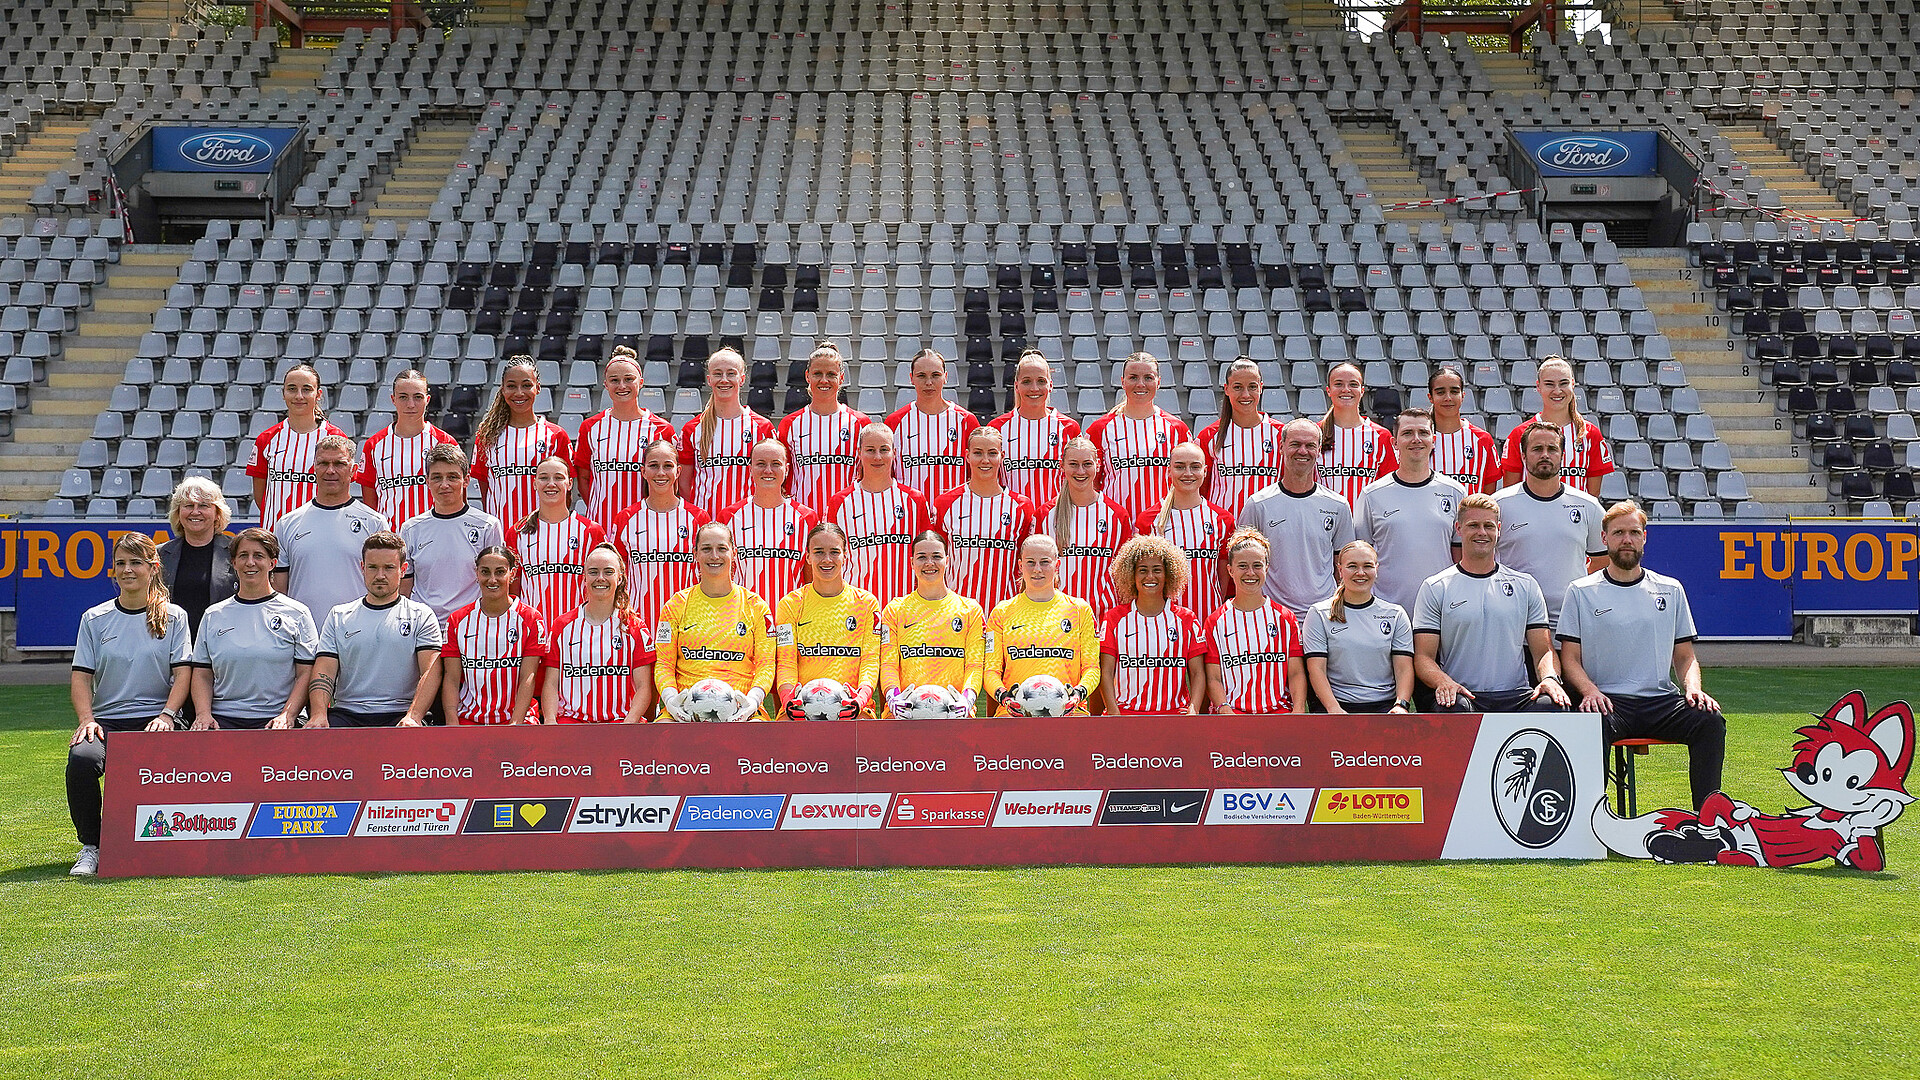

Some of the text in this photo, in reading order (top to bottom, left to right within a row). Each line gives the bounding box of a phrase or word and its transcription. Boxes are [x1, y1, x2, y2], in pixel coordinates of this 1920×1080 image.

[196, 136, 256, 162] Ford
[1553, 141, 1611, 165] Ford
[1678, 270, 1692, 280] 12
[1692, 292, 1705, 303] 11
[1705, 316, 1720, 327] 10
[1727, 340, 1734, 351] 9
[1742, 365, 1749, 377] 8
[1757, 391, 1765, 403] 7
[1774, 418, 1782, 430] 6
[1791, 446, 1799, 458] 5
[594, 459, 642, 473] Badeno
[698, 455, 751, 468] Badenov
[797, 454, 855, 467] Badenova
[903, 454, 964, 468] Badenova
[270, 469, 316, 483] Badeno
[492, 463, 537, 479] Badeno
[1218, 463, 1278, 477] Badenova
[1318, 464, 1376, 477] Badenova
[379, 474, 426, 490] Badeno
[1452, 474, 1478, 484] nova
[1809, 475, 1817, 487] 4
[1829, 504, 1836, 516] 3
[849, 532, 911, 549] Badenova
[953, 534, 1015, 550] Badenova
[631, 550, 694, 563] Badenova
[738, 546, 800, 561] Badenova
[1062, 545, 1112, 557] adenova
[1184, 549, 1218, 559] enova
[1719, 531, 1920, 581] EUROP
[523, 562, 584, 576] Badenova
[681, 646, 744, 661] Badenova
[797, 643, 860, 656] Badenova
[901, 644, 964, 658] Badenova
[1008, 645, 1073, 659] Badenova
[1119, 654, 1186, 668] Badenova
[1222, 652, 1286, 669] Badenova
[563, 664, 630, 678] Badenova
[855, 756, 946, 774] Badenova
[973, 755, 1065, 771] Badenova
[1091, 753, 1183, 770] Badenova
[1210, 751, 1301, 769] Badenova
[1330, 750, 1422, 768] Badenova
[381, 763, 473, 781] Badenova
[500, 761, 592, 779] Badenova
[619, 759, 711, 777] Badenova
[737, 758, 829, 775] Badenova
[138, 768, 232, 785] Badenova
[261, 766, 354, 783] Badenova
[1352, 793, 1410, 810] LOTTO
[273, 805, 338, 819] EUROPA
[367, 806, 435, 822] hilzinger
[576, 803, 671, 828] stryker
[688, 805, 773, 821] Badenova
[921, 808, 985, 823] Sparkasse
[1004, 802, 1092, 816] WeberHaus
[171, 811, 237, 835] Rothaus
[1352, 812, 1411, 821] Baden-Württemberg
[281, 820, 325, 834] PARK
[367, 821, 450, 833] Fenster und Türen
